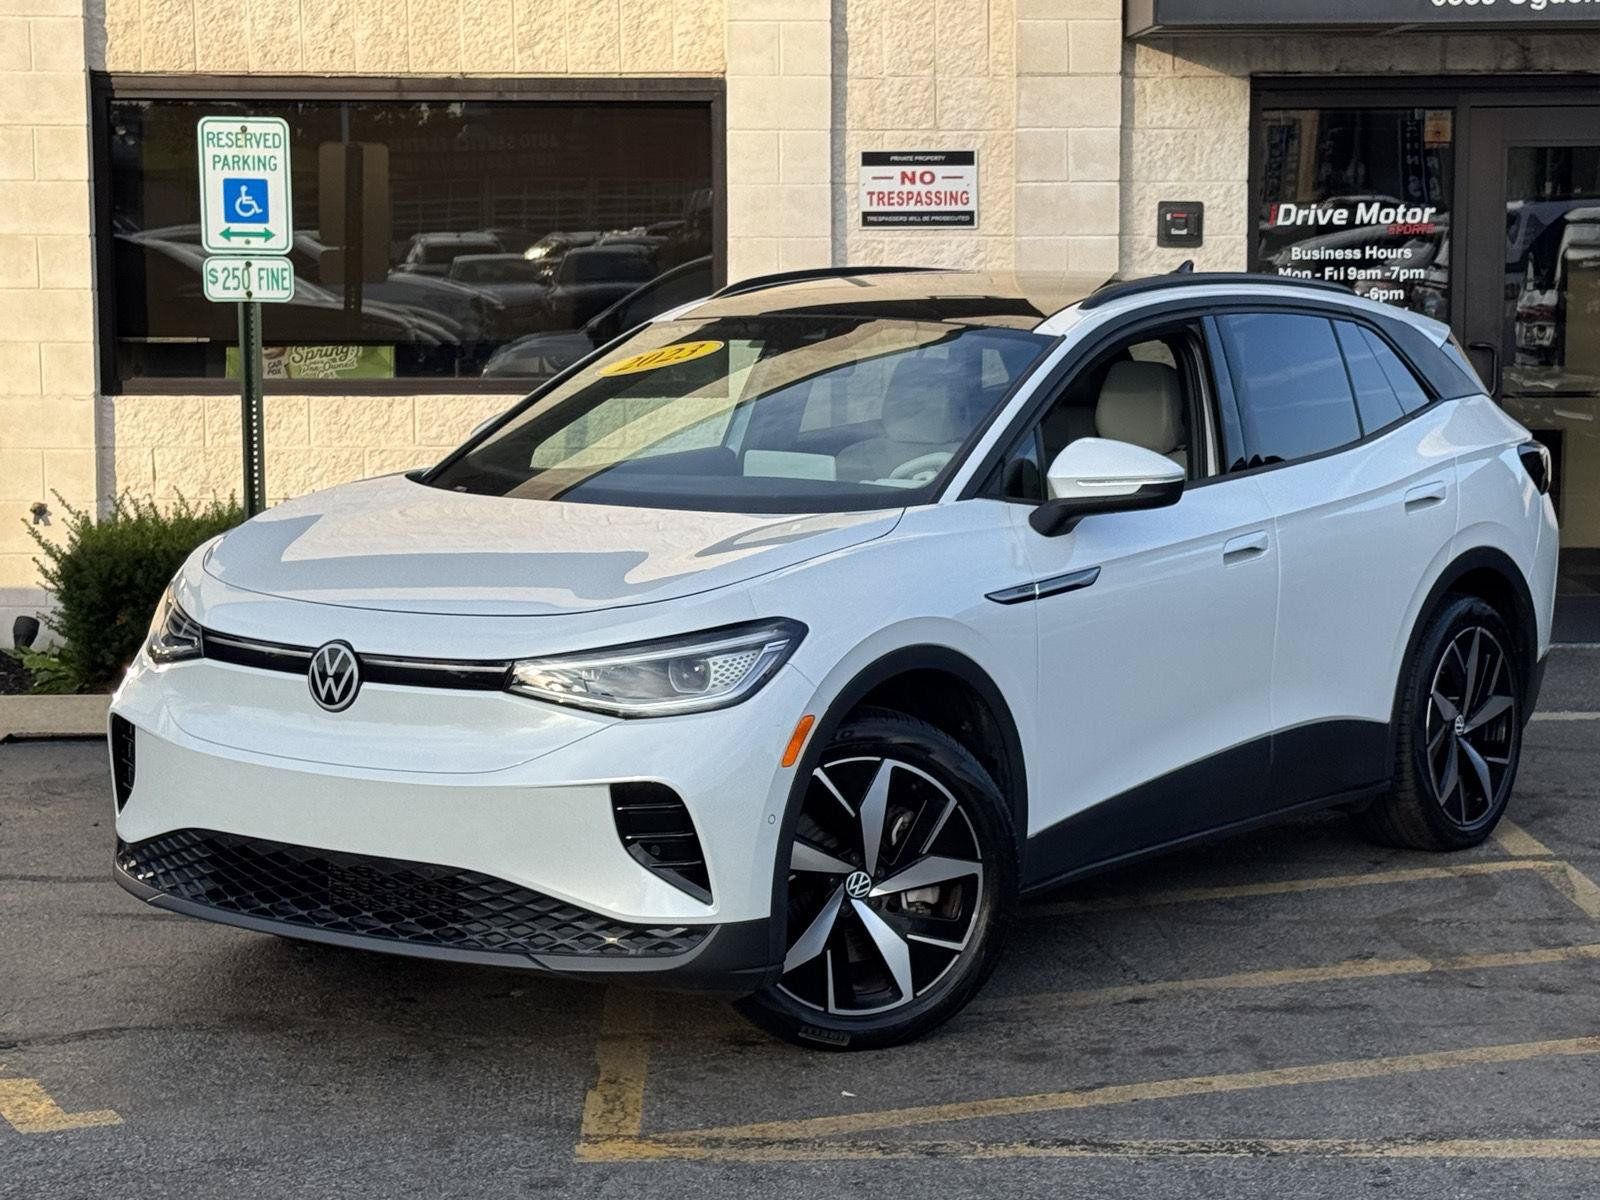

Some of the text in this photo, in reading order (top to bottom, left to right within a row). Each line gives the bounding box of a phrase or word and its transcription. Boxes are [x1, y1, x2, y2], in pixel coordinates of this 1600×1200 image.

[206, 131, 282, 149] RESERVED
[212, 154, 278, 172] PARKING
[900, 170, 936, 186] NO
[866, 190, 970, 207] TRESPASSING
[1355, 202, 1436, 226] Motor
[1291, 246, 1413, 261] Business Hours
[208, 266, 290, 291] $250 FINE
[1347, 266, 1382, 280] 9am
